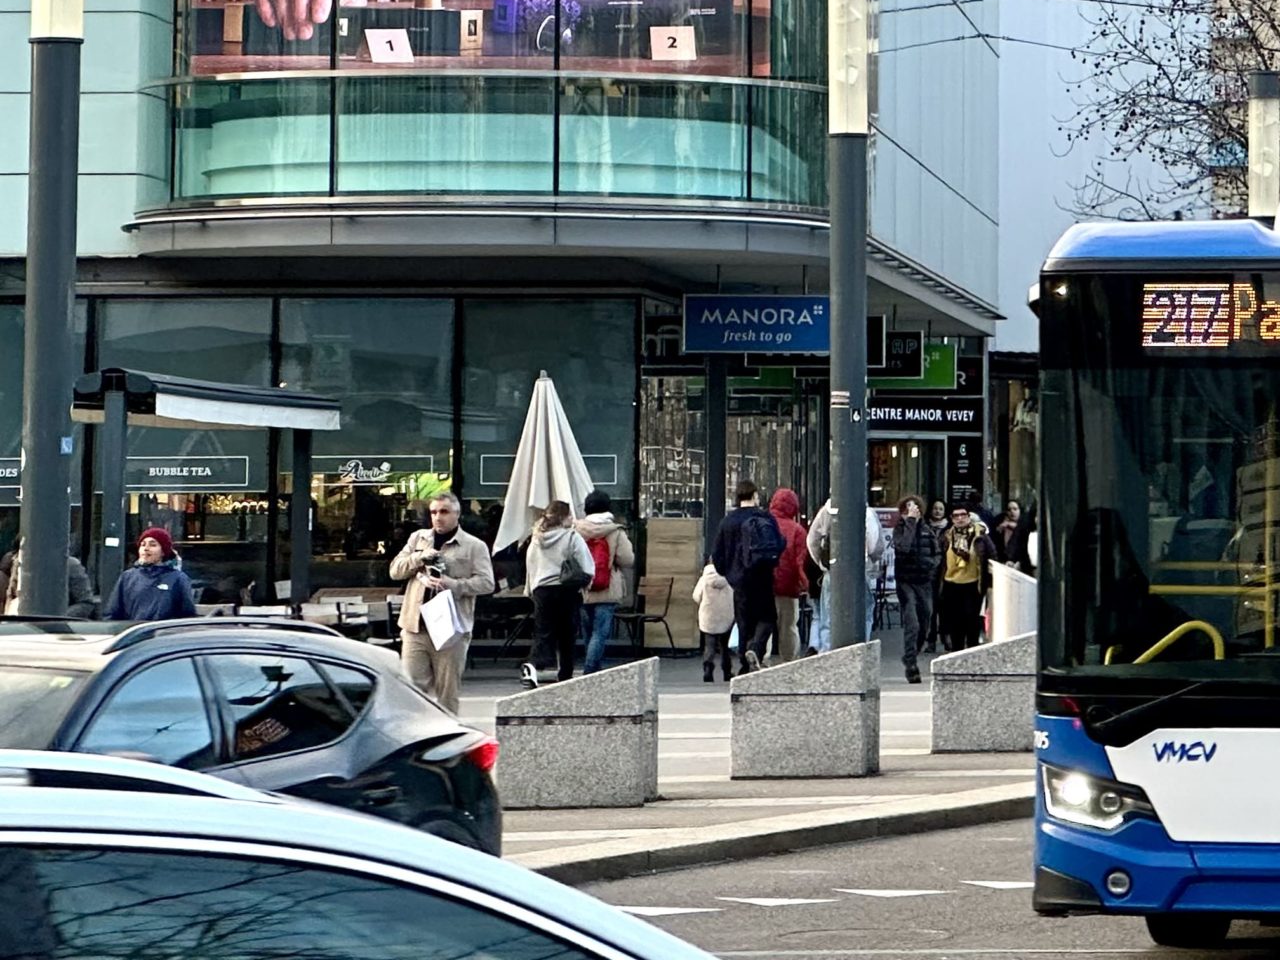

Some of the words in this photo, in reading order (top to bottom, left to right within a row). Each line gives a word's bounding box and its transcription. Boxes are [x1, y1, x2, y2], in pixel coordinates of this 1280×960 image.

[385, 40, 395, 52] 1
[667, 36, 678, 48] 2
[701, 308, 814, 325] MANORA
[723, 330, 756, 343] fresh
[759, 331, 773, 341] to
[775, 331, 792, 344] go
[905, 408, 942, 421] MANOR
[946, 410, 974, 421] VEVEY
[149, 467, 189, 476] BUBBLE
[191, 467, 212, 476] TEA
[1153, 741, 1217, 763] VMCV
